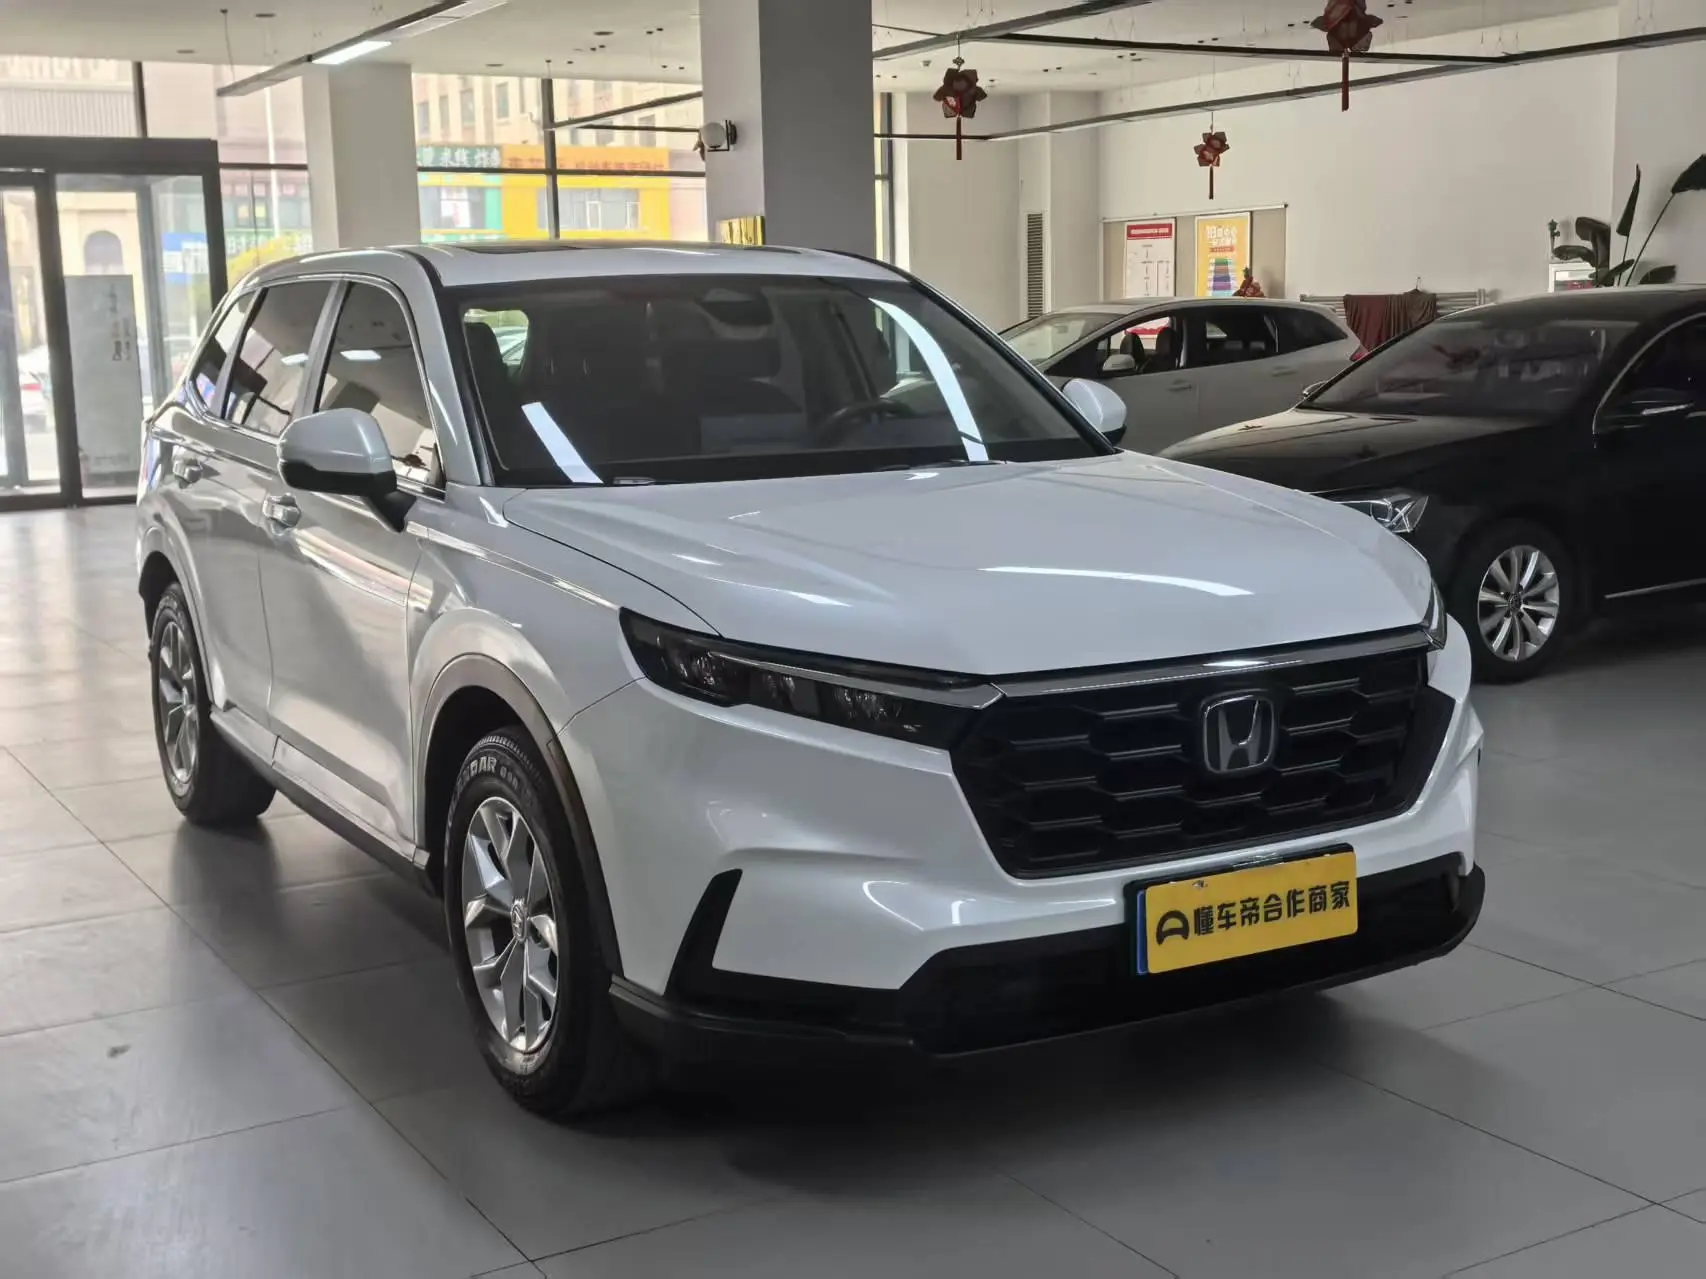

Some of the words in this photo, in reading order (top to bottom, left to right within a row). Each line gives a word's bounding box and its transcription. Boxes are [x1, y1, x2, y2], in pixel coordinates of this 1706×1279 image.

[1194, 881, 1350, 936] 懂车帝合作商家
